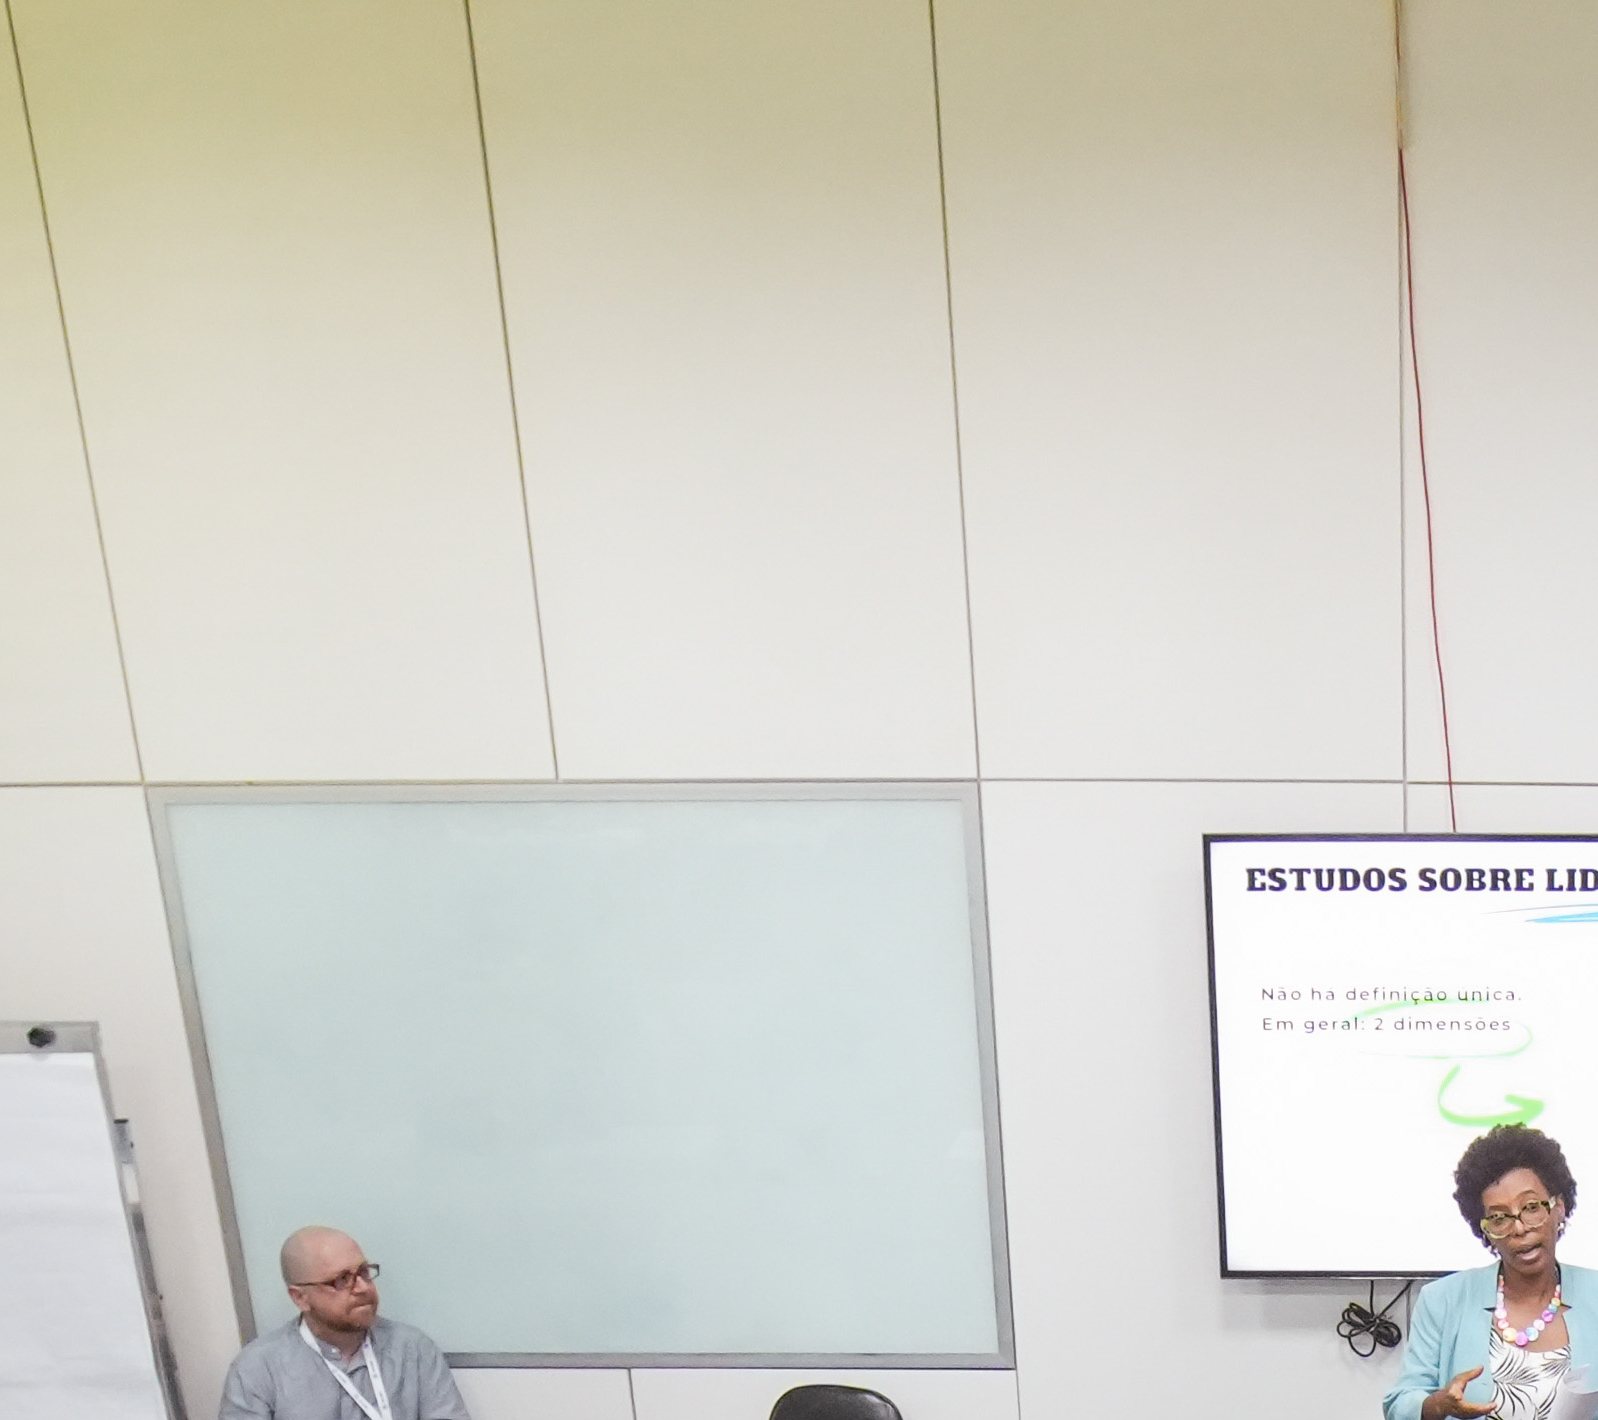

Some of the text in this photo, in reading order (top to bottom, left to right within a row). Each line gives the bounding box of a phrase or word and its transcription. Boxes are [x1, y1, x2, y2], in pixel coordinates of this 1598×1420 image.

[1246, 867, 1408, 892] ESTUDOS
[1418, 867, 1535, 892] SOBRE
[1261, 986, 1522, 1005] Não há definição única.
[1262, 1016, 1511, 1033] Em geral: 2 dimensões
